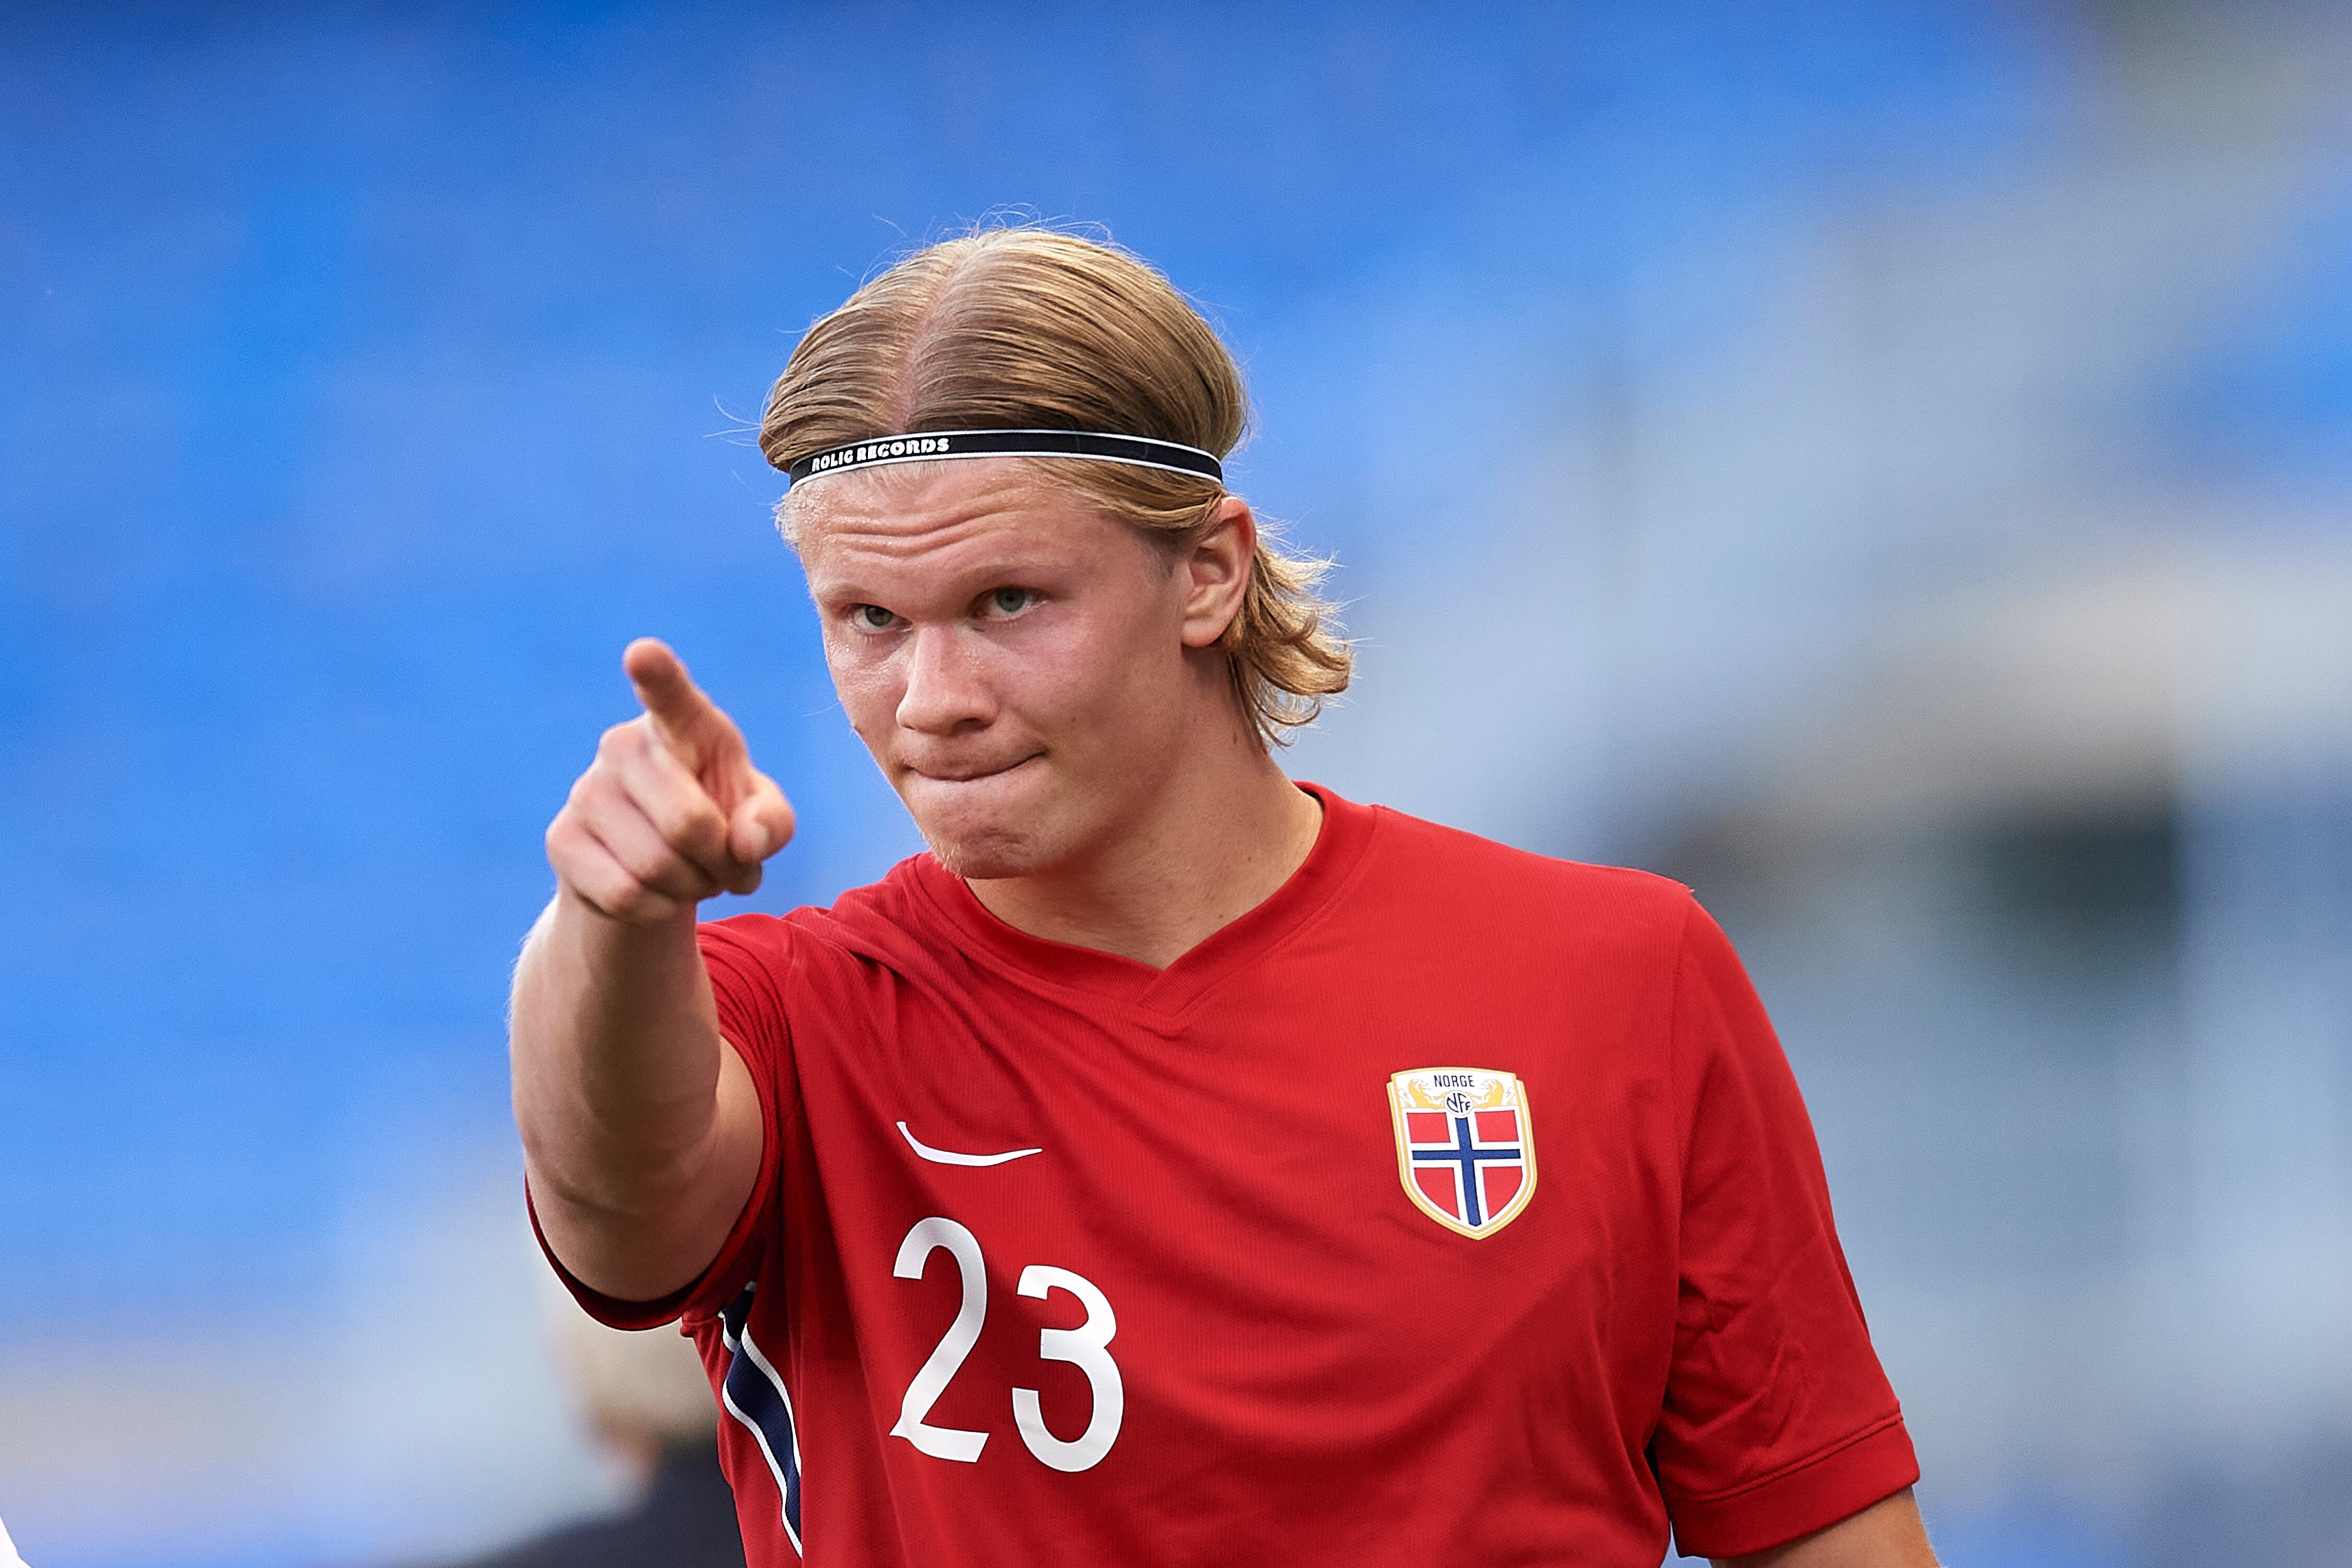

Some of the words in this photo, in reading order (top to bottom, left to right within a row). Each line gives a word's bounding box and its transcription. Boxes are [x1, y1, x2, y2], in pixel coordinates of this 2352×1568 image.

[857, 438, 949, 461] RECORDS
[1433, 1075, 1475, 1087] NORGE
[889, 1216, 1124, 1473] 23
